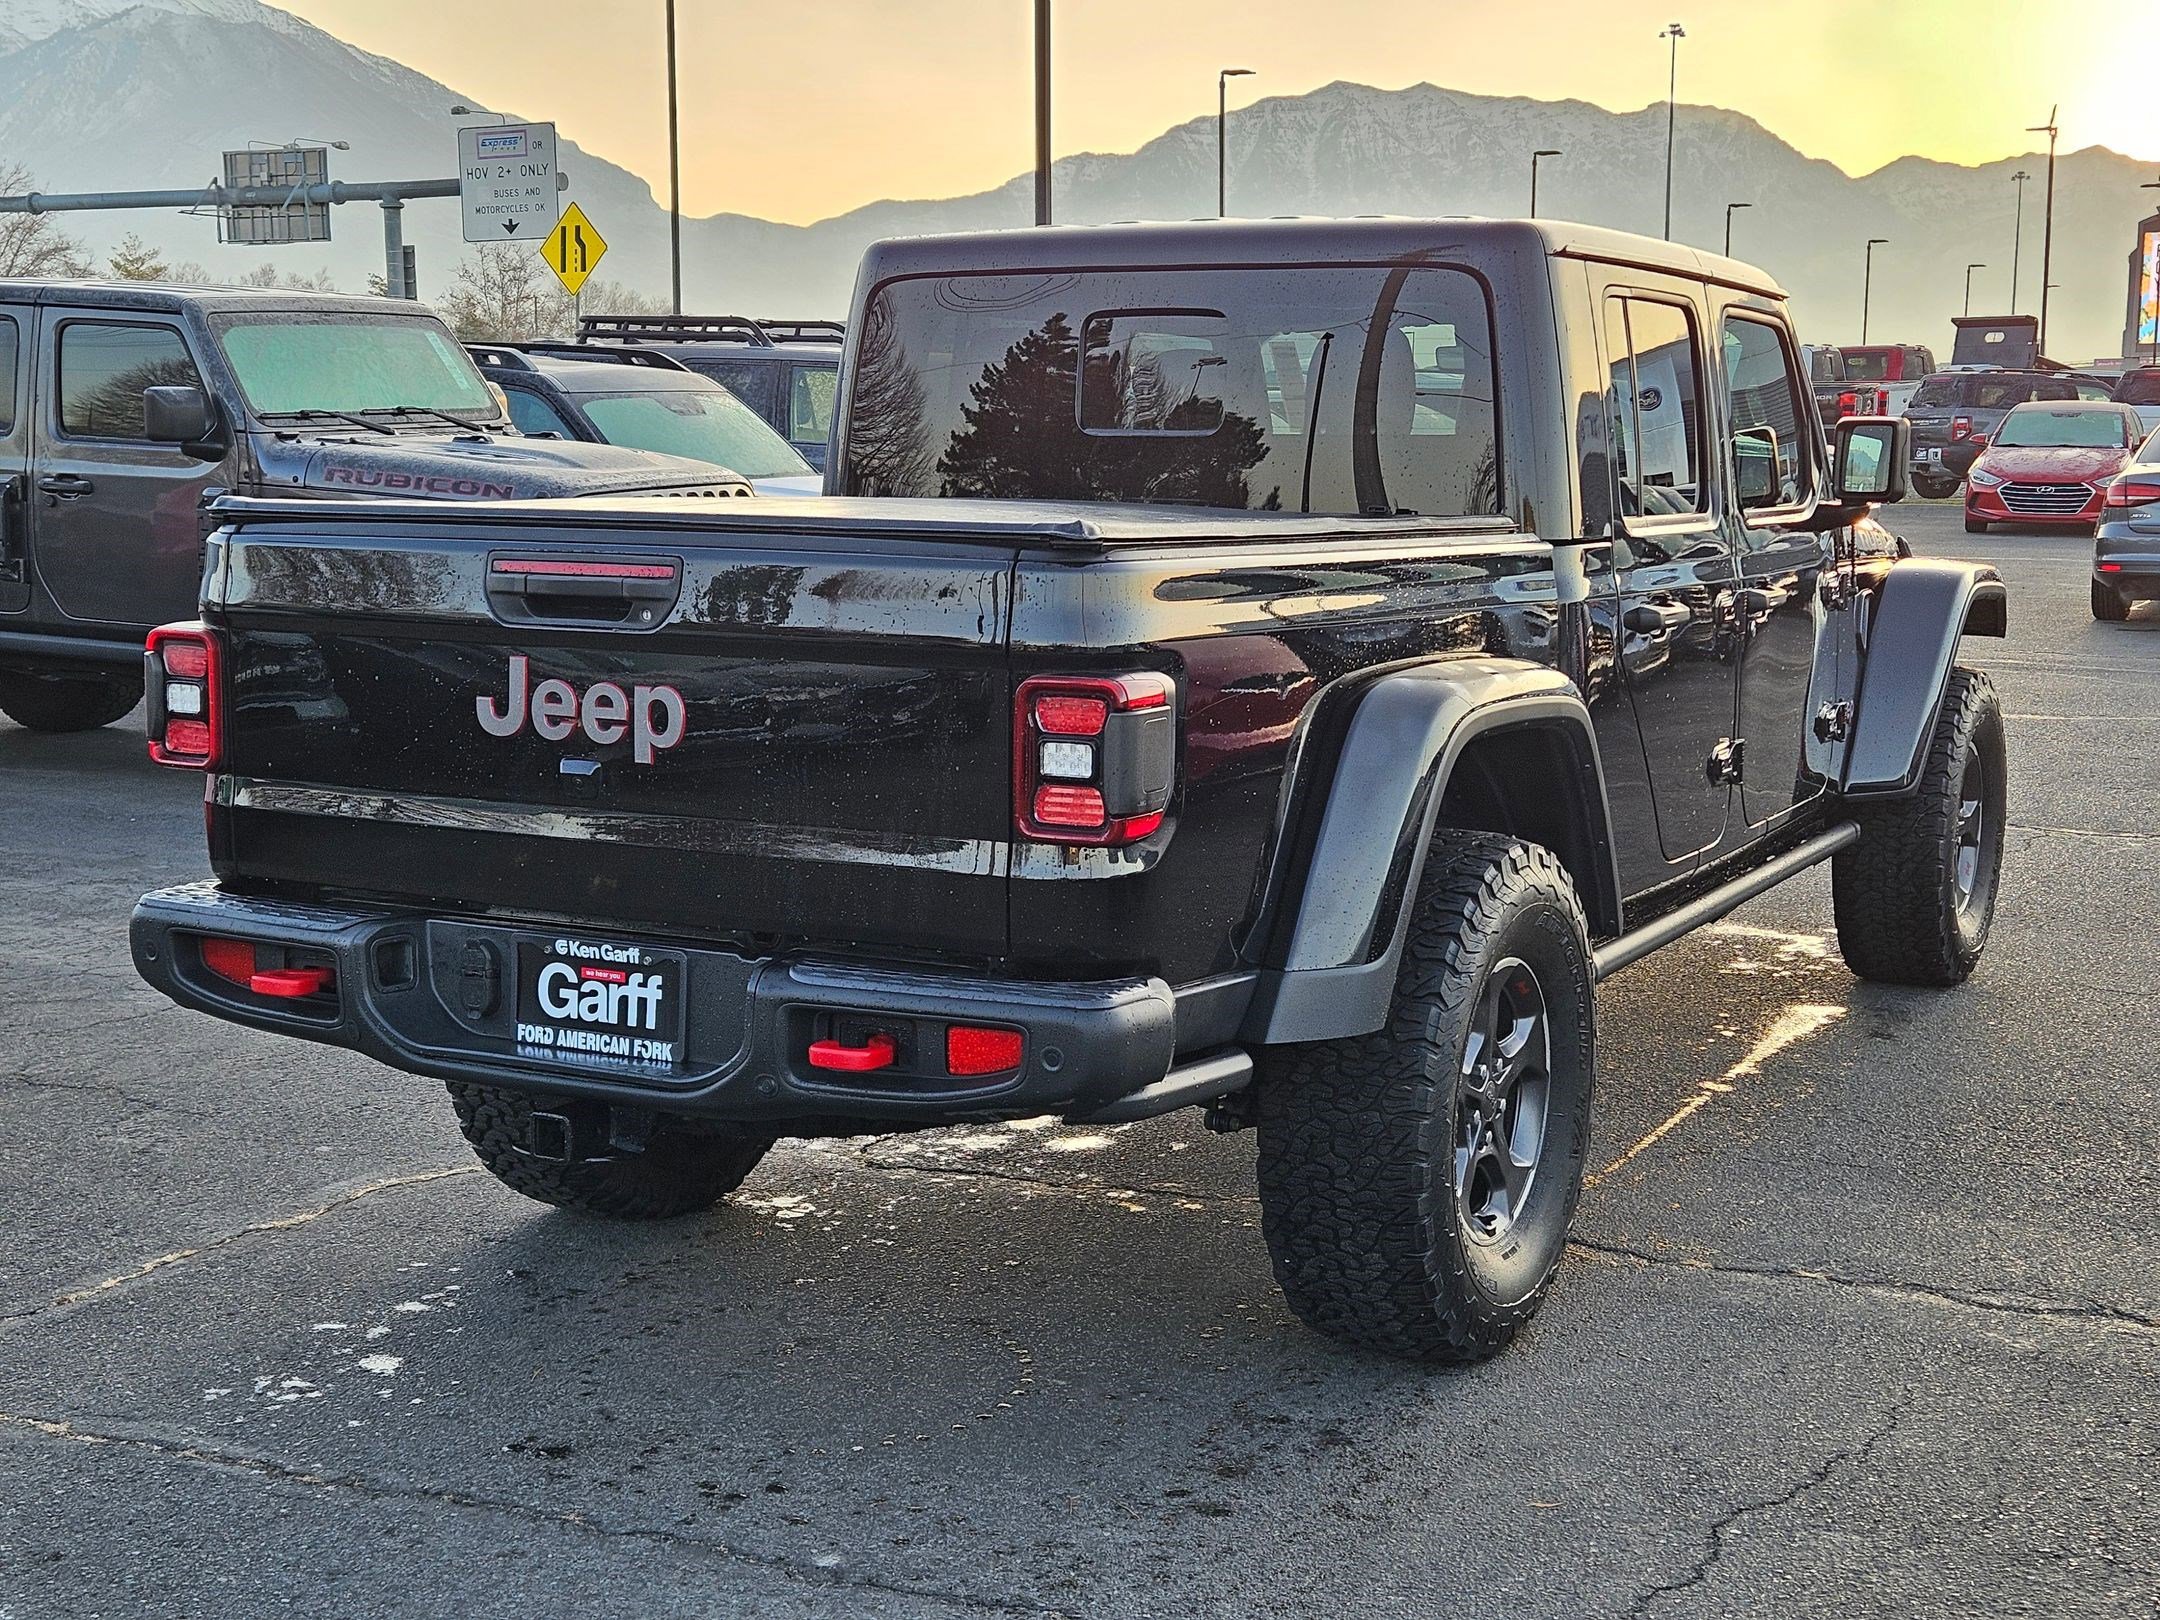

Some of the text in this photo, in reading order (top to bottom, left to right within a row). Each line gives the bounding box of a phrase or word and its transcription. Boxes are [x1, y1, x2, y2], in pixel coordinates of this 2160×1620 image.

[481, 137, 519, 151] Express
[532, 140, 543, 150] OR
[466, 163, 549, 180] HOV 2+ ONLY
[493, 187, 541, 198] BUSES AND
[475, 202, 546, 215] MOTORCYCLES OK
[324, 466, 514, 500] RUBICON
[476, 655, 687, 765] Jeep
[569, 940, 600, 960] Ken
[601, 944, 640, 964] Garff
[595, 970, 609, 978] hear
[538, 962, 663, 1030] Garff
[517, 1023, 673, 1062] FORD AMERICAN FORK
